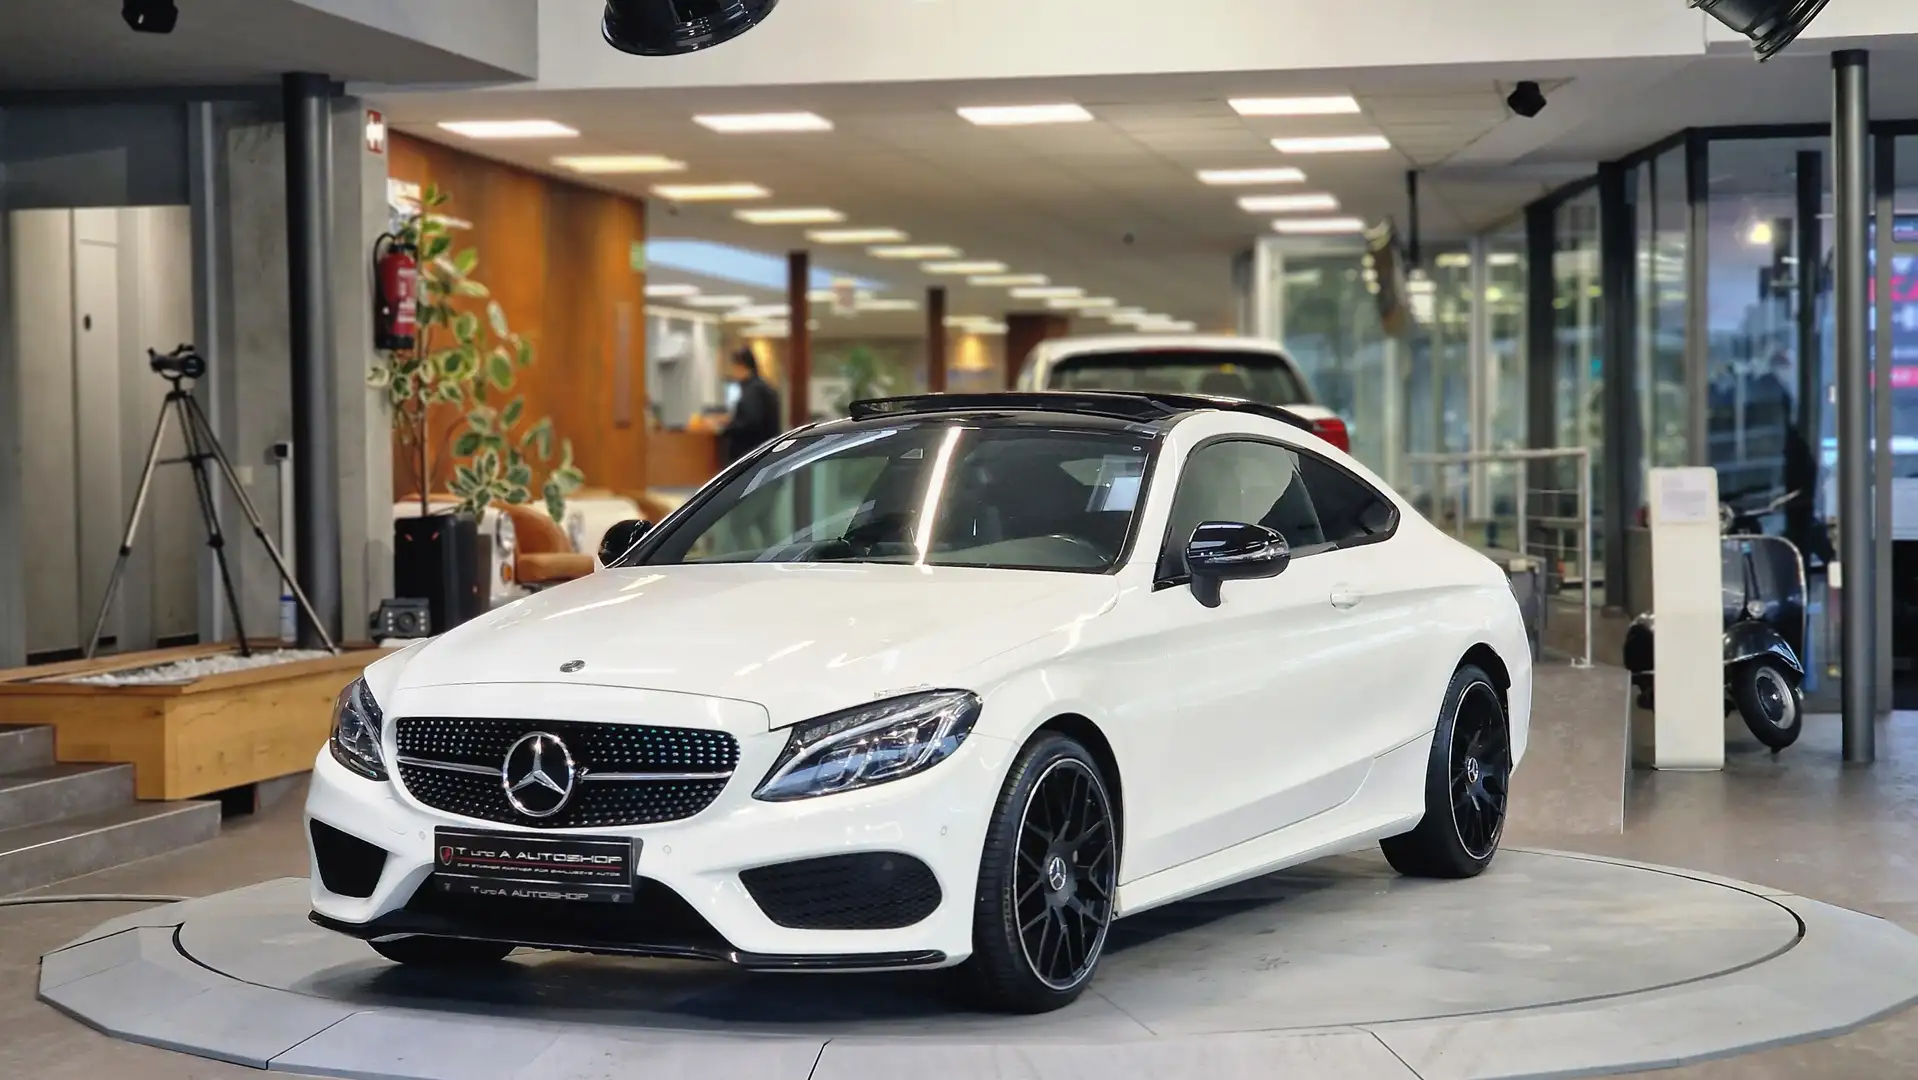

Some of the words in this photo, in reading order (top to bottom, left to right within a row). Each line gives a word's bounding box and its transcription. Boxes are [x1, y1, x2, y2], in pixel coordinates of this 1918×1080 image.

[499, 850, 511, 858] A
[516, 851, 622, 864] AUTOSHOP
[512, 889, 589, 900] AUTOSHOP
